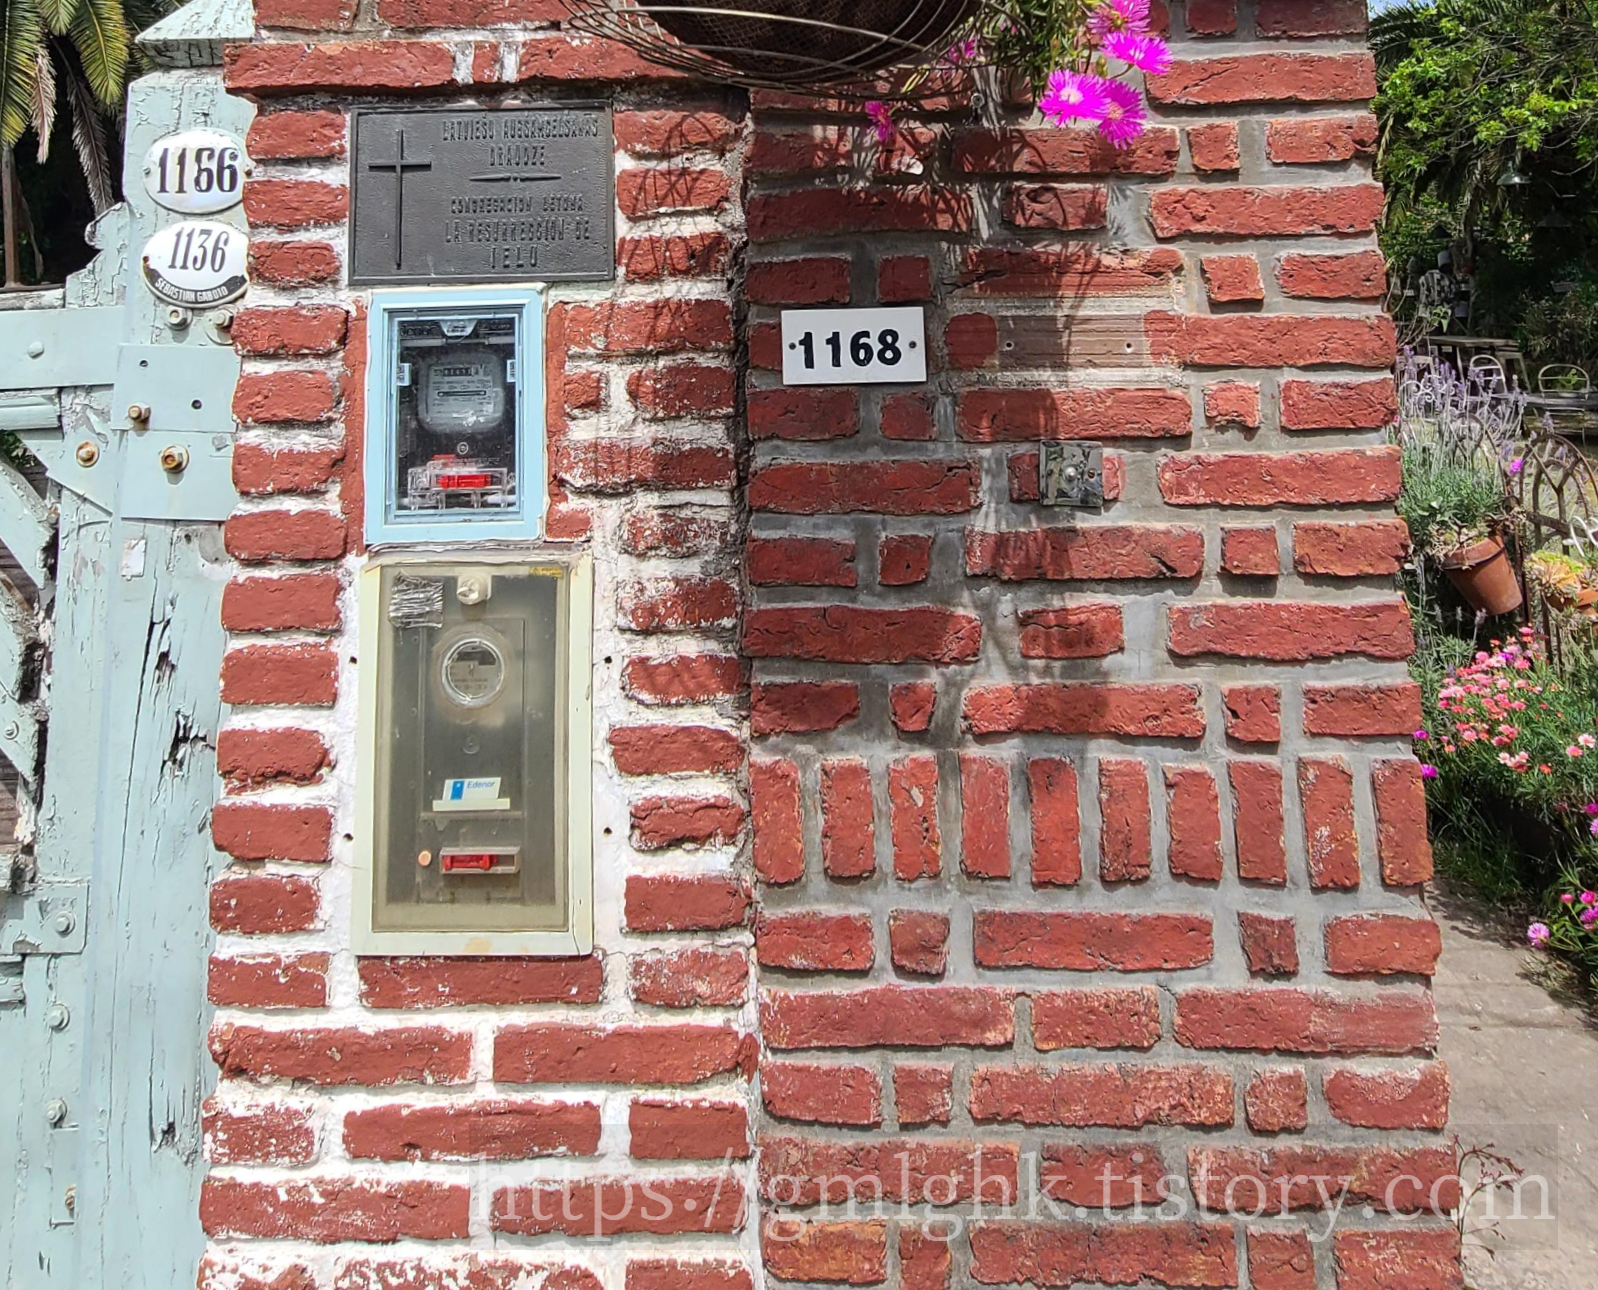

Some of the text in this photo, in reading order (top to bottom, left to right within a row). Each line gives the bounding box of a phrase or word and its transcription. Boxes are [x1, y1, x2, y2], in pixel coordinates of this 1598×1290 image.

[168, 227, 229, 273] 1136
[155, 277, 196, 303] SEBASTIAN
[798, 328, 902, 370] 1168
[467, 780, 495, 789] Edenor
